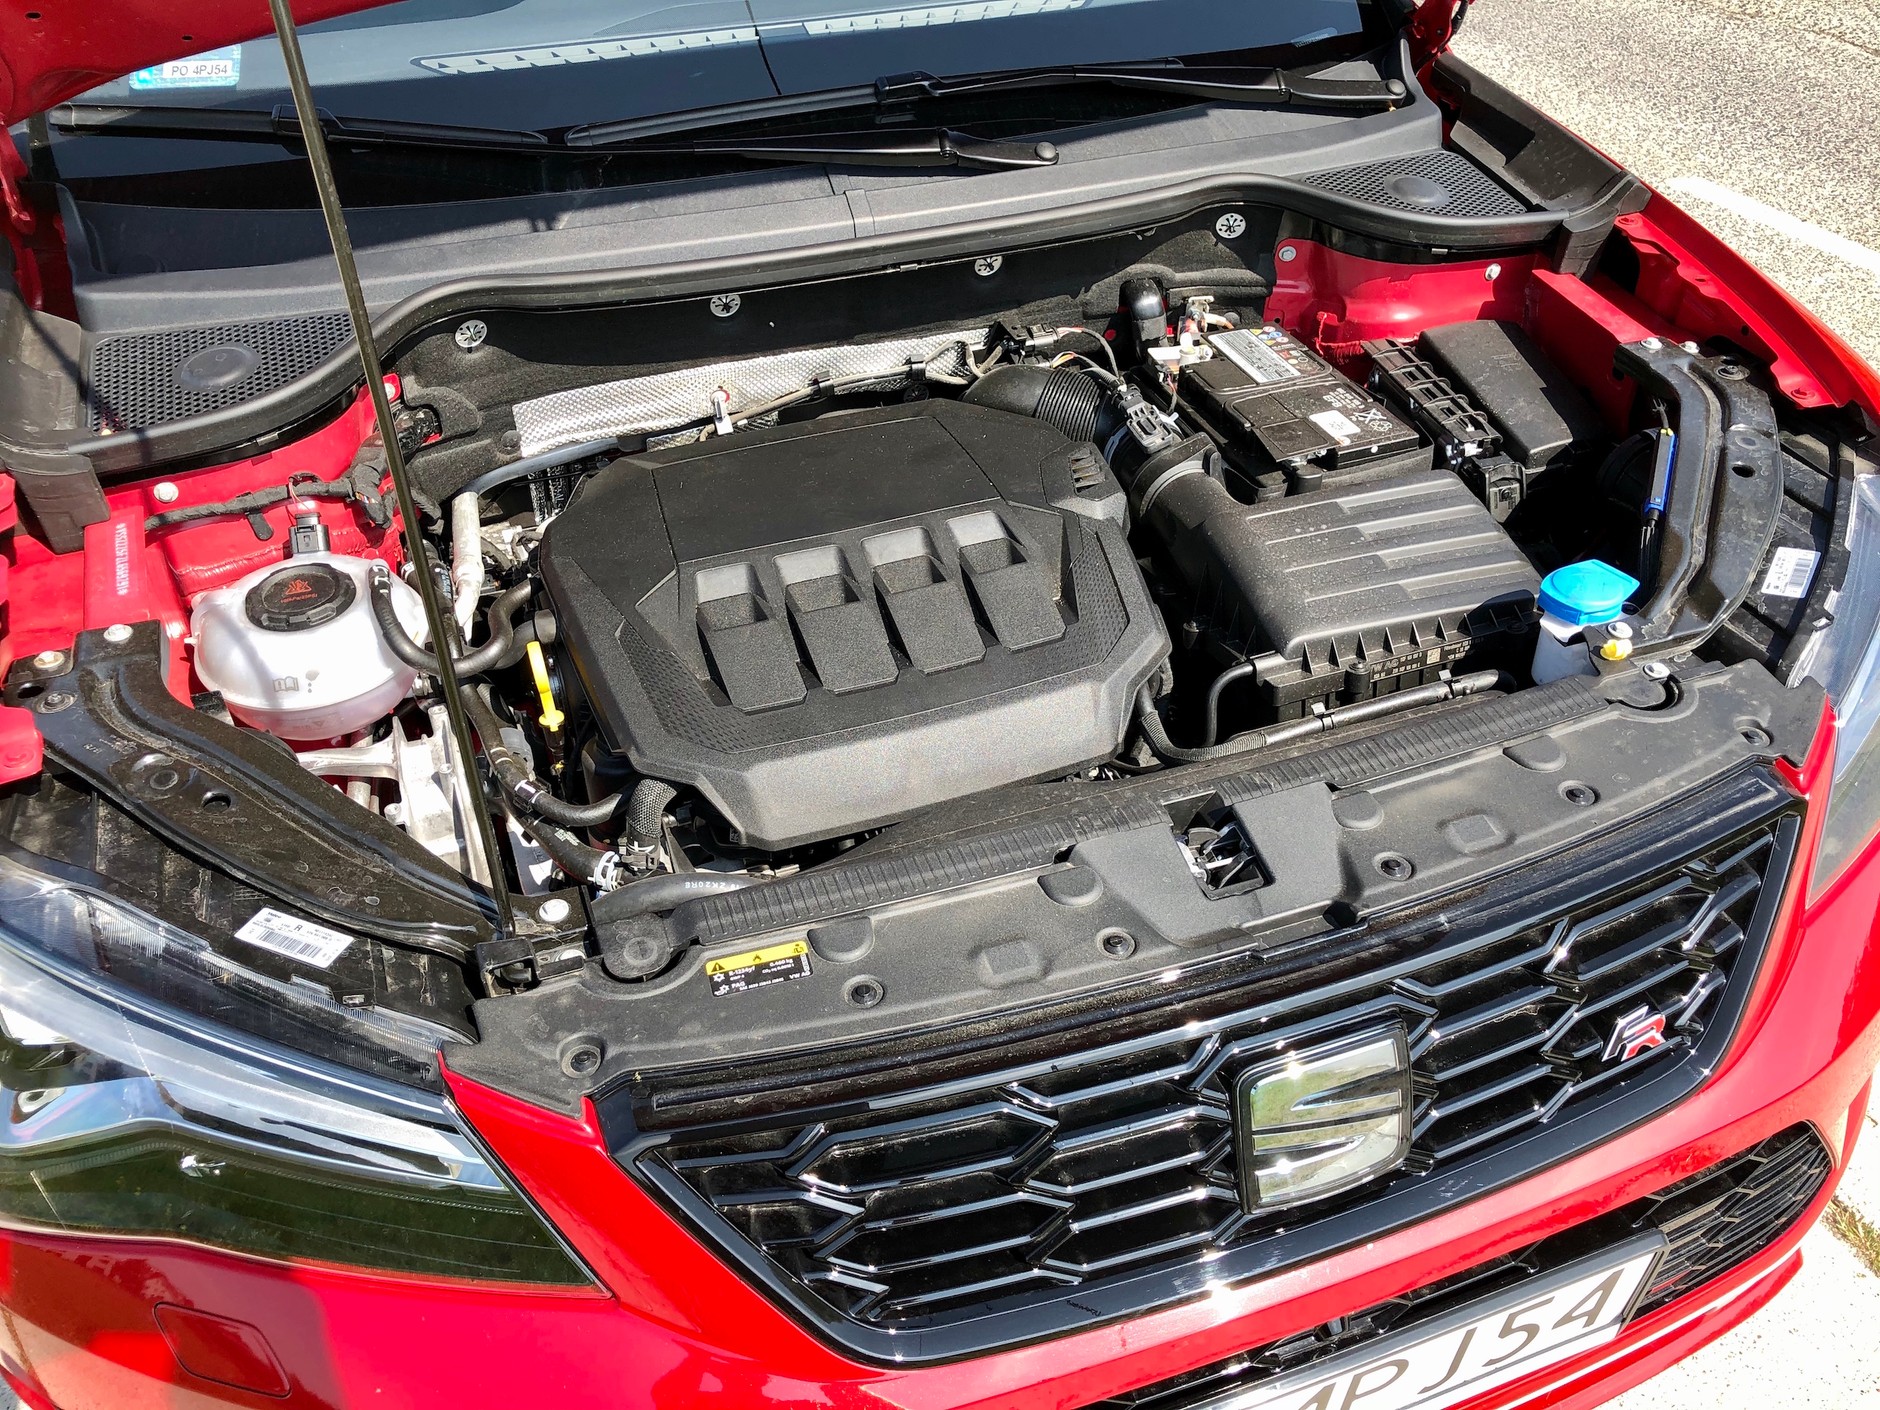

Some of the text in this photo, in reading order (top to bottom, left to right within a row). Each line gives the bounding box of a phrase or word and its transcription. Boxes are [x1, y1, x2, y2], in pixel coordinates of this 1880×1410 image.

[171, 64, 228, 76] PO 4PJ54
[294, 924, 303, 932] R
